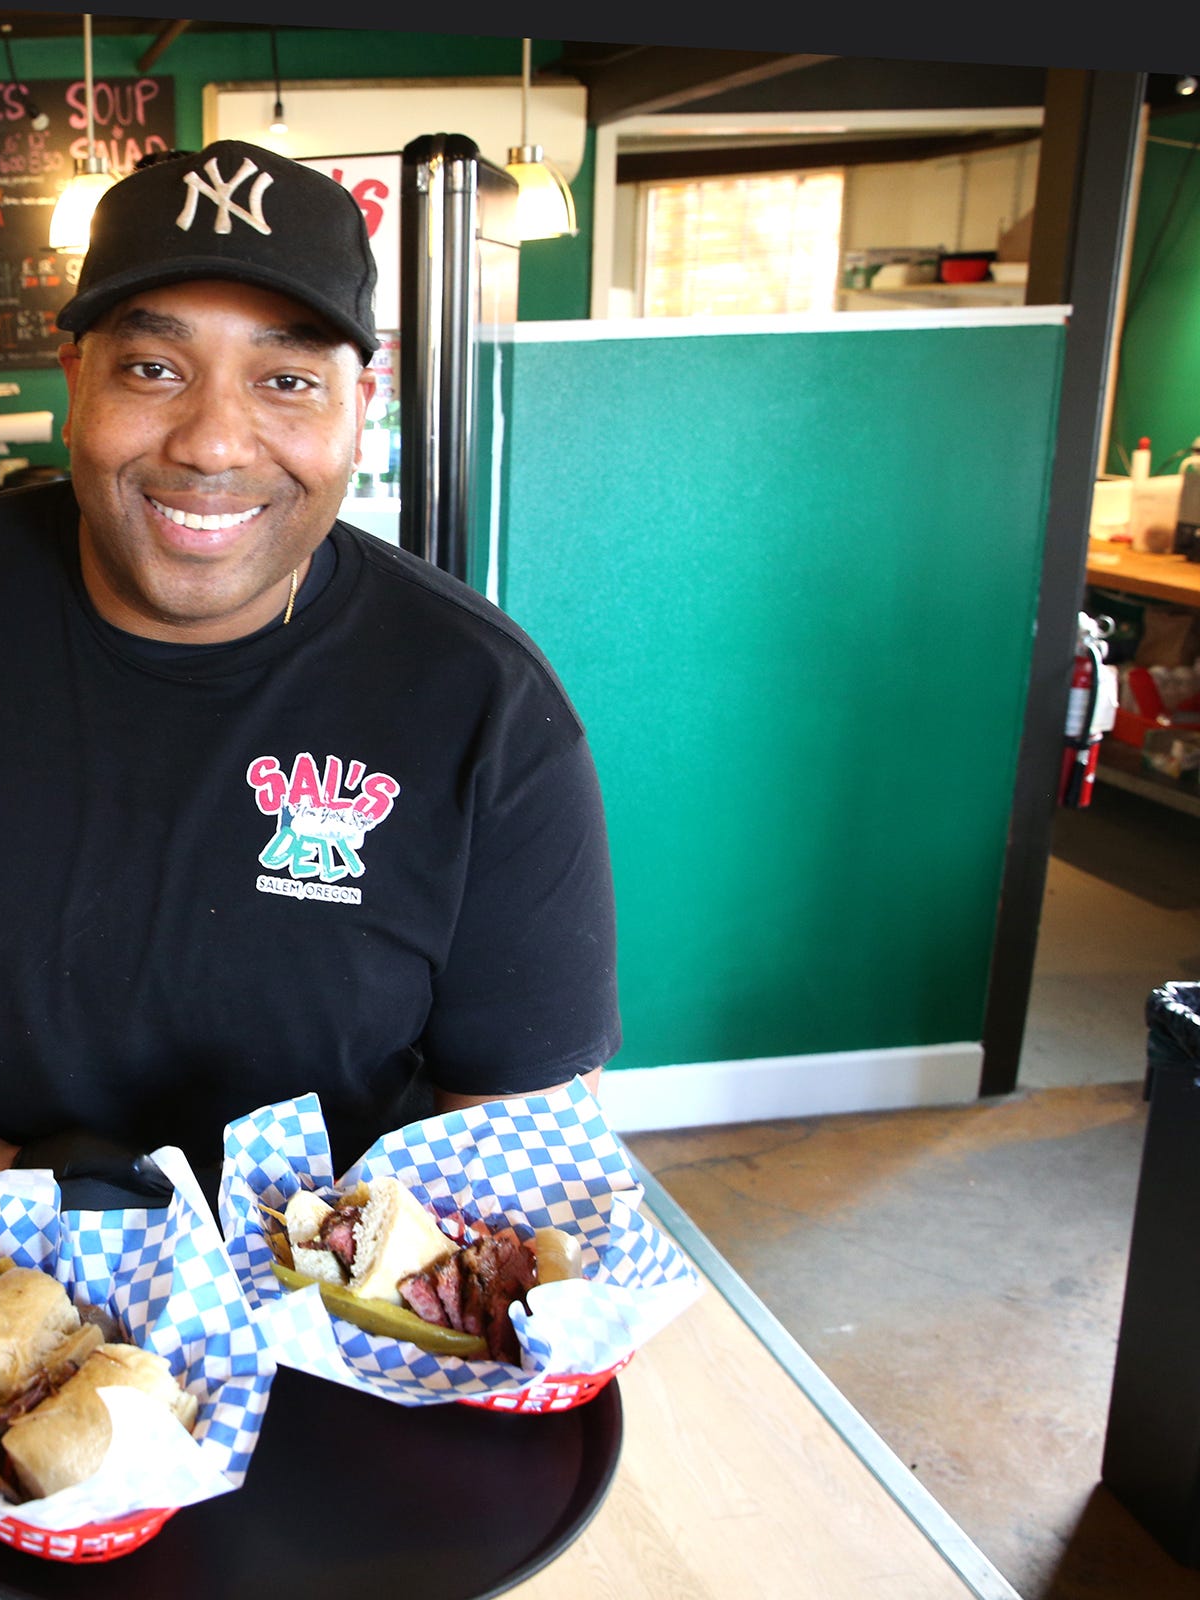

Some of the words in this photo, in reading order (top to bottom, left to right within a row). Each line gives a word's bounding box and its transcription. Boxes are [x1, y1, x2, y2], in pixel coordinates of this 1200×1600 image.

[65, 79, 159, 130] SOUP
[175, 156, 274, 236] NY
[248, 753, 399, 823] SAL'S
[260, 827, 364, 881] DELI
[305, 884, 360, 901] OREGON
